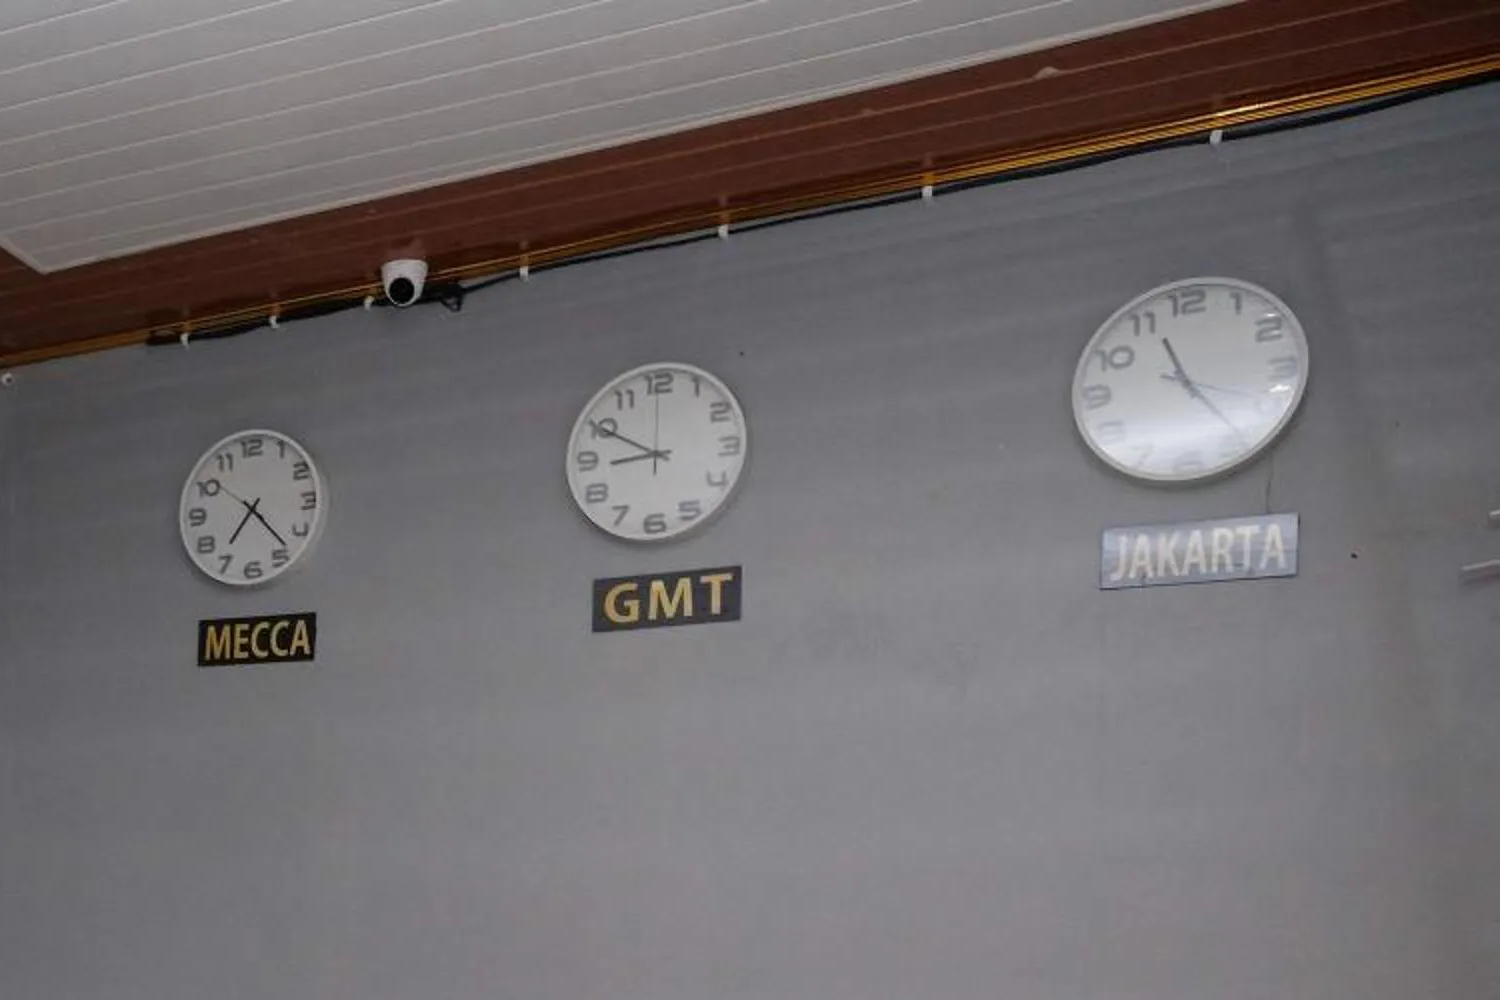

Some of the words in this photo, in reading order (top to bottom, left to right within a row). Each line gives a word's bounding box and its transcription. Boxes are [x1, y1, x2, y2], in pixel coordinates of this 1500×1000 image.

[1169, 289, 1206, 318] 12
[1230, 292, 1242, 315] 1
[1130, 312, 1156, 336] 11
[1254, 316, 1283, 342] 2
[1095, 345, 1135, 371] 10
[644, 373, 674, 395] 12
[691, 377, 700, 398] 1
[615, 389, 634, 411] 11
[1082, 384, 1112, 410] 9
[710, 401, 731, 422] 2
[589, 418, 618, 439] 10
[241, 439, 263, 458] 12
[277, 439, 285, 458] 1
[717, 436, 740, 457] 3
[217, 453, 233, 471] 11
[293, 461, 310, 480] 2
[576, 451, 599, 472] 9
[196, 478, 221, 498] 10
[585, 483, 609, 504] 8
[300, 491, 316, 511] 3
[678, 500, 702, 521] 5
[189, 508, 207, 526] 9
[612, 505, 629, 526] 7
[643, 513, 667, 534] 6
[196, 536, 215, 554] 8
[1110, 523, 1287, 581] JAKARTA
[219, 554, 234, 574] 7
[272, 549, 290, 568] 5
[243, 561, 263, 579] 6
[604, 572, 733, 624] GMT
[204, 619, 311, 661] MECCA
